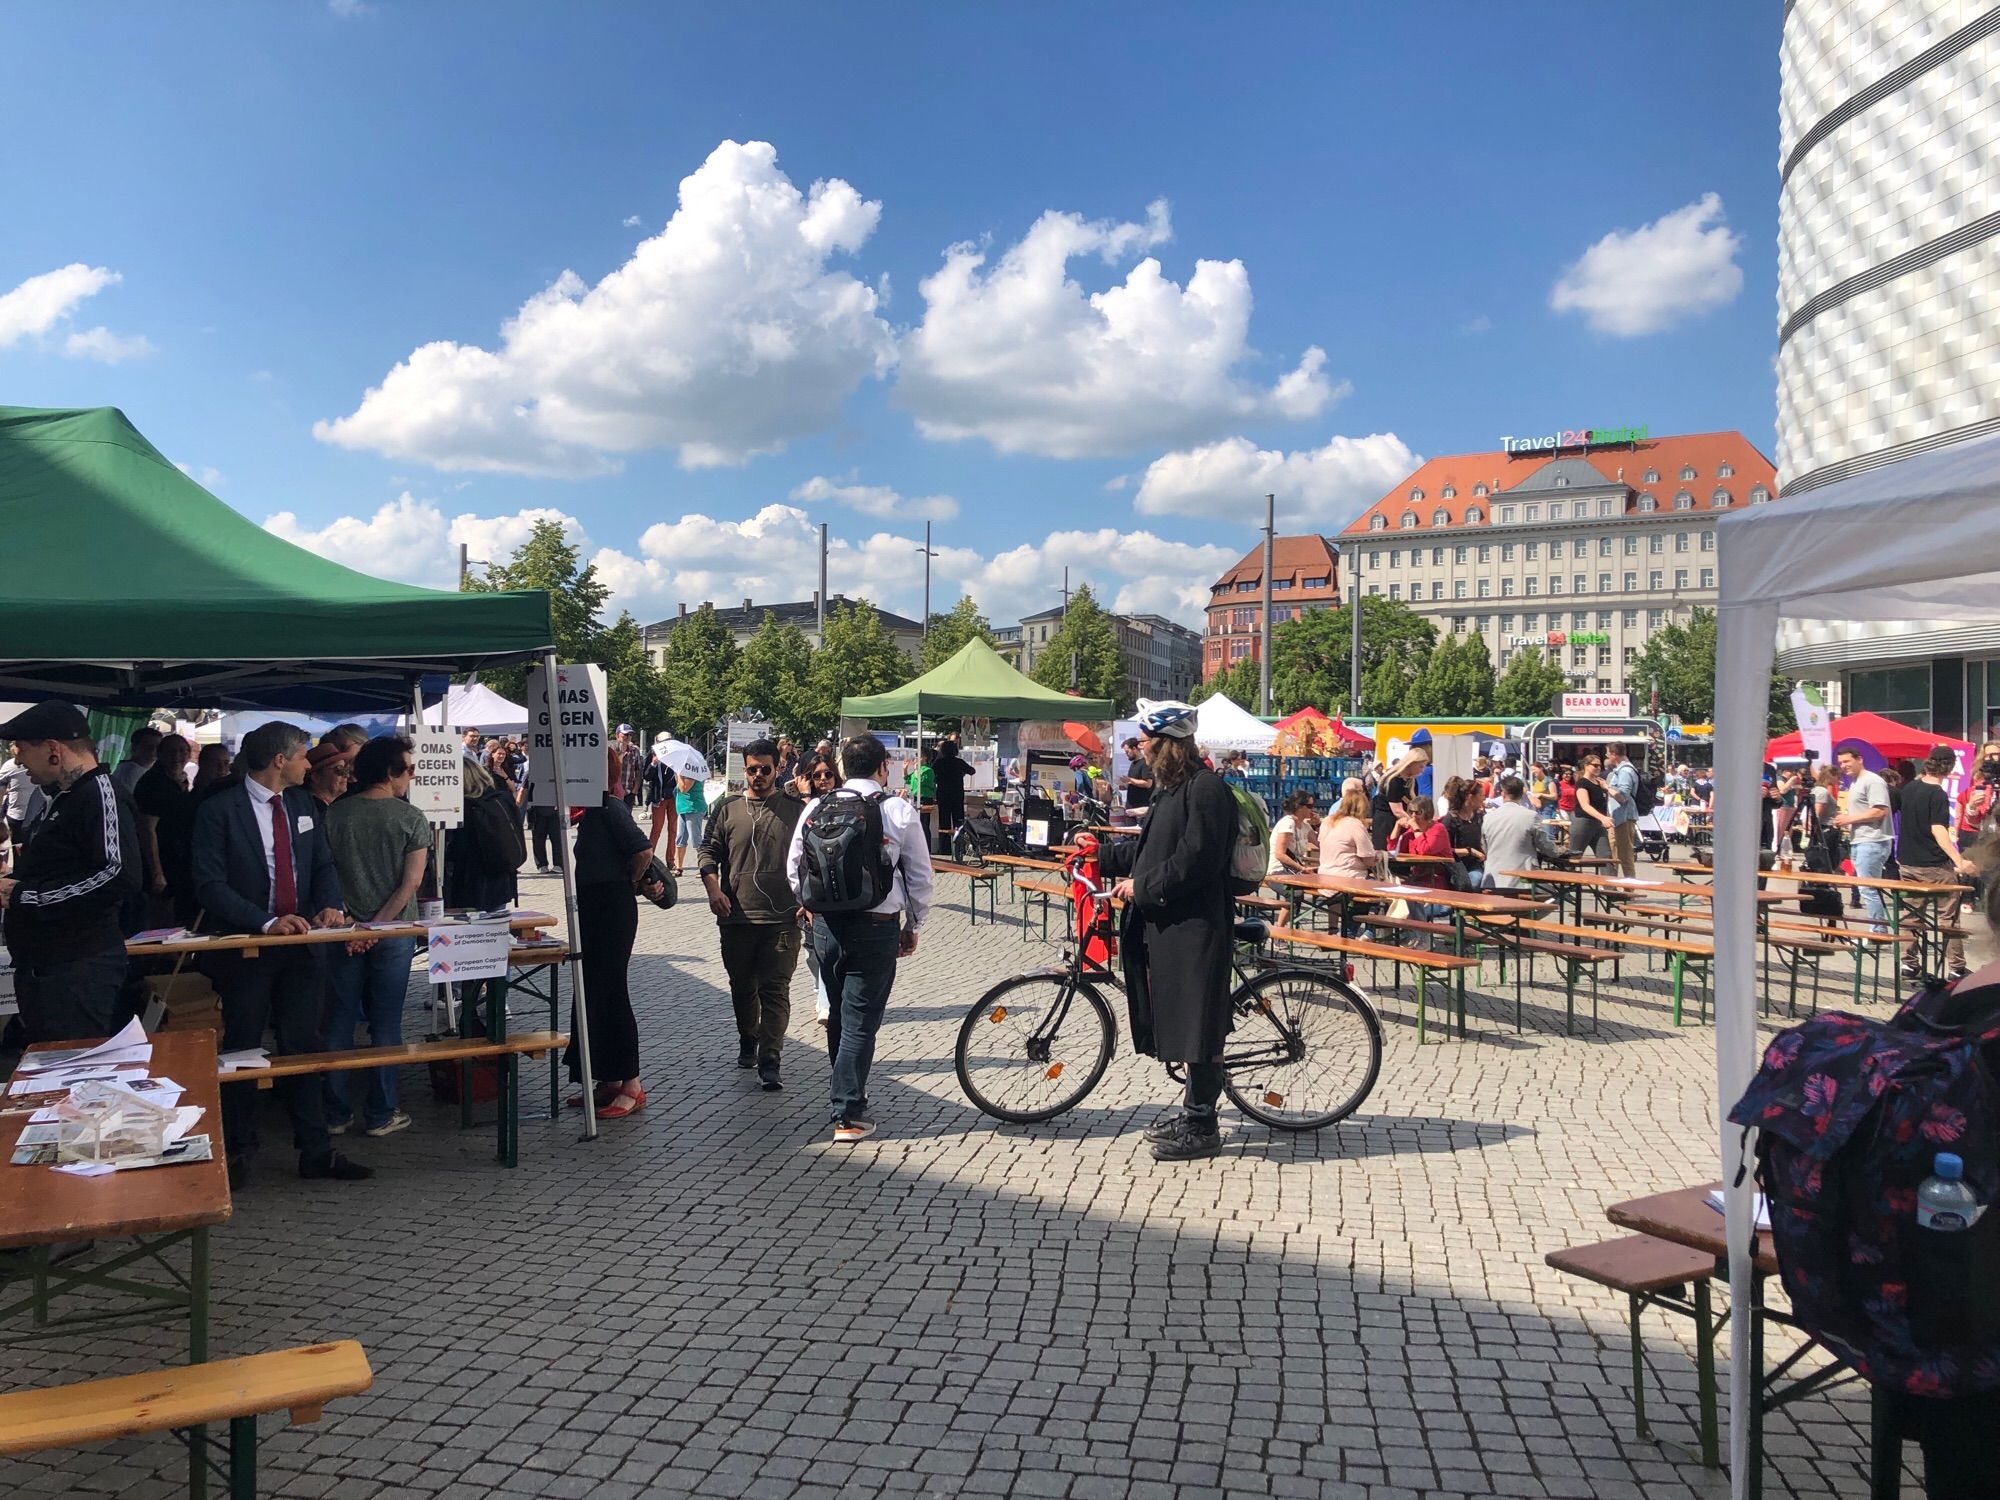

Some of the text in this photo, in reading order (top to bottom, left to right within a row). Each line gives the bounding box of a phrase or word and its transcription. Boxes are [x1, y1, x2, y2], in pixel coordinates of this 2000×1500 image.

[1565, 697, 1627, 706] BEAR BOWL
[538, 711, 594, 726] GGEN
[535, 733, 600, 748] REHTS
[421, 743, 453, 754] OMAS
[417, 759, 456, 770] GEGEN
[684, 762, 708, 774] OMAS
[415, 775, 459, 786] RECHTS
[461, 964, 497, 972] Democracy
